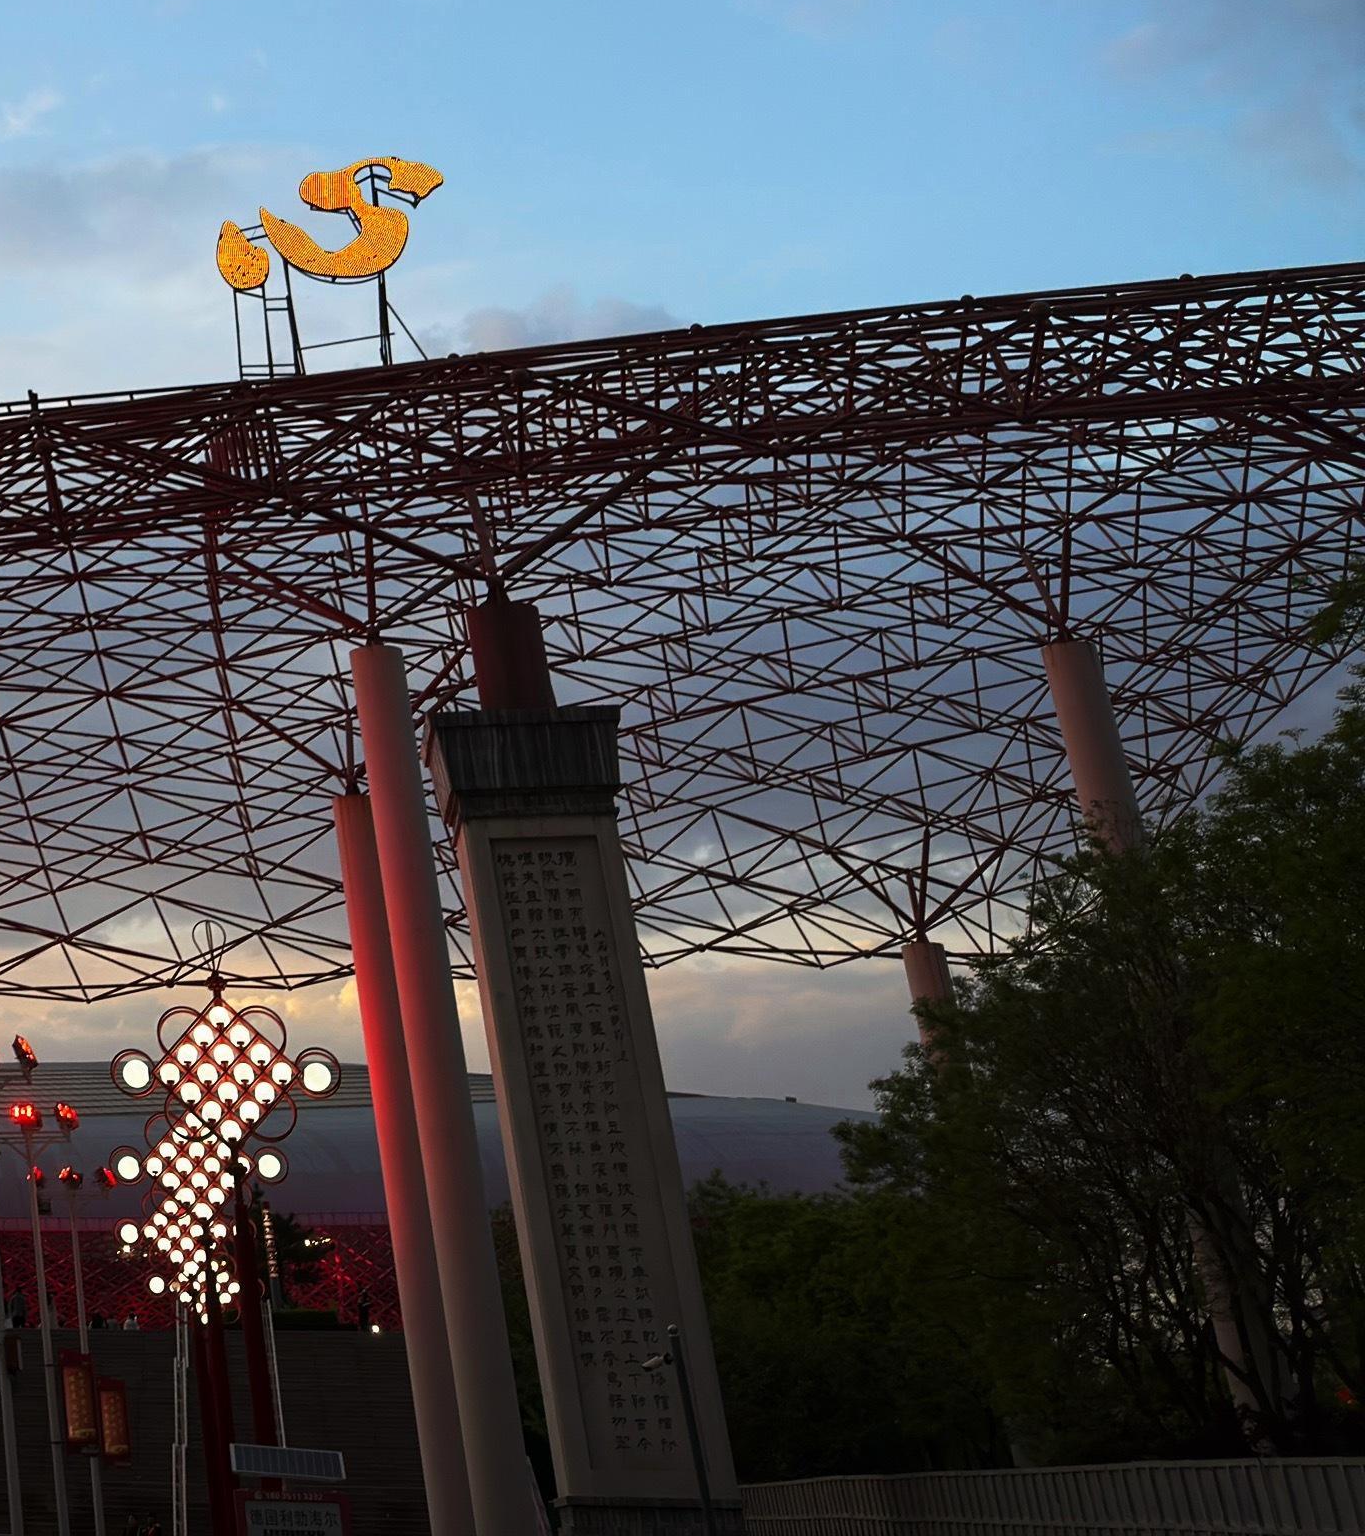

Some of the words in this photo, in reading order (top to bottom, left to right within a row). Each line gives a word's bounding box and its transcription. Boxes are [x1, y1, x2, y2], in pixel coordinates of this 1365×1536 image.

[249, 1508, 340, 1527] 德国利勃海尔
